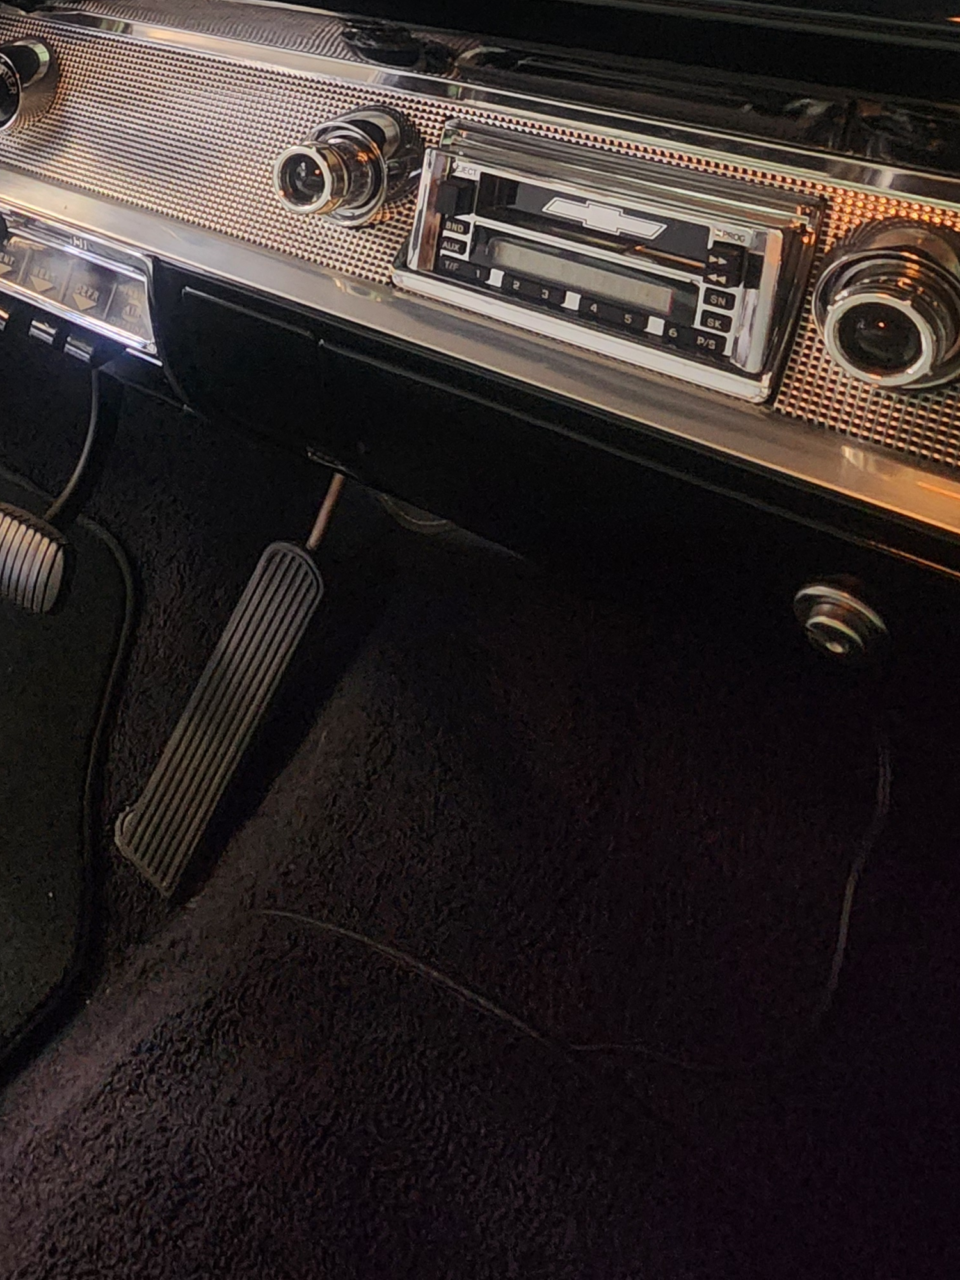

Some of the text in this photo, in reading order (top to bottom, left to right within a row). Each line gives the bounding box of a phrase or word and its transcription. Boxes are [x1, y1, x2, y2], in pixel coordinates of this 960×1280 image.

[445, 221, 464, 233] BND
[723, 229, 746, 243] PROG
[442, 240, 461, 253] AUX
[709, 294, 726, 307] SN
[475, 269, 481, 279] 1
[512, 279, 521, 291] 2
[541, 288, 550, 299] 3
[590, 303, 598, 314] 4
[624, 313, 633, 324] 5
[668, 327, 678, 338] 6
[696, 336, 717, 350] P/S
[706, 317, 722, 330] SK
